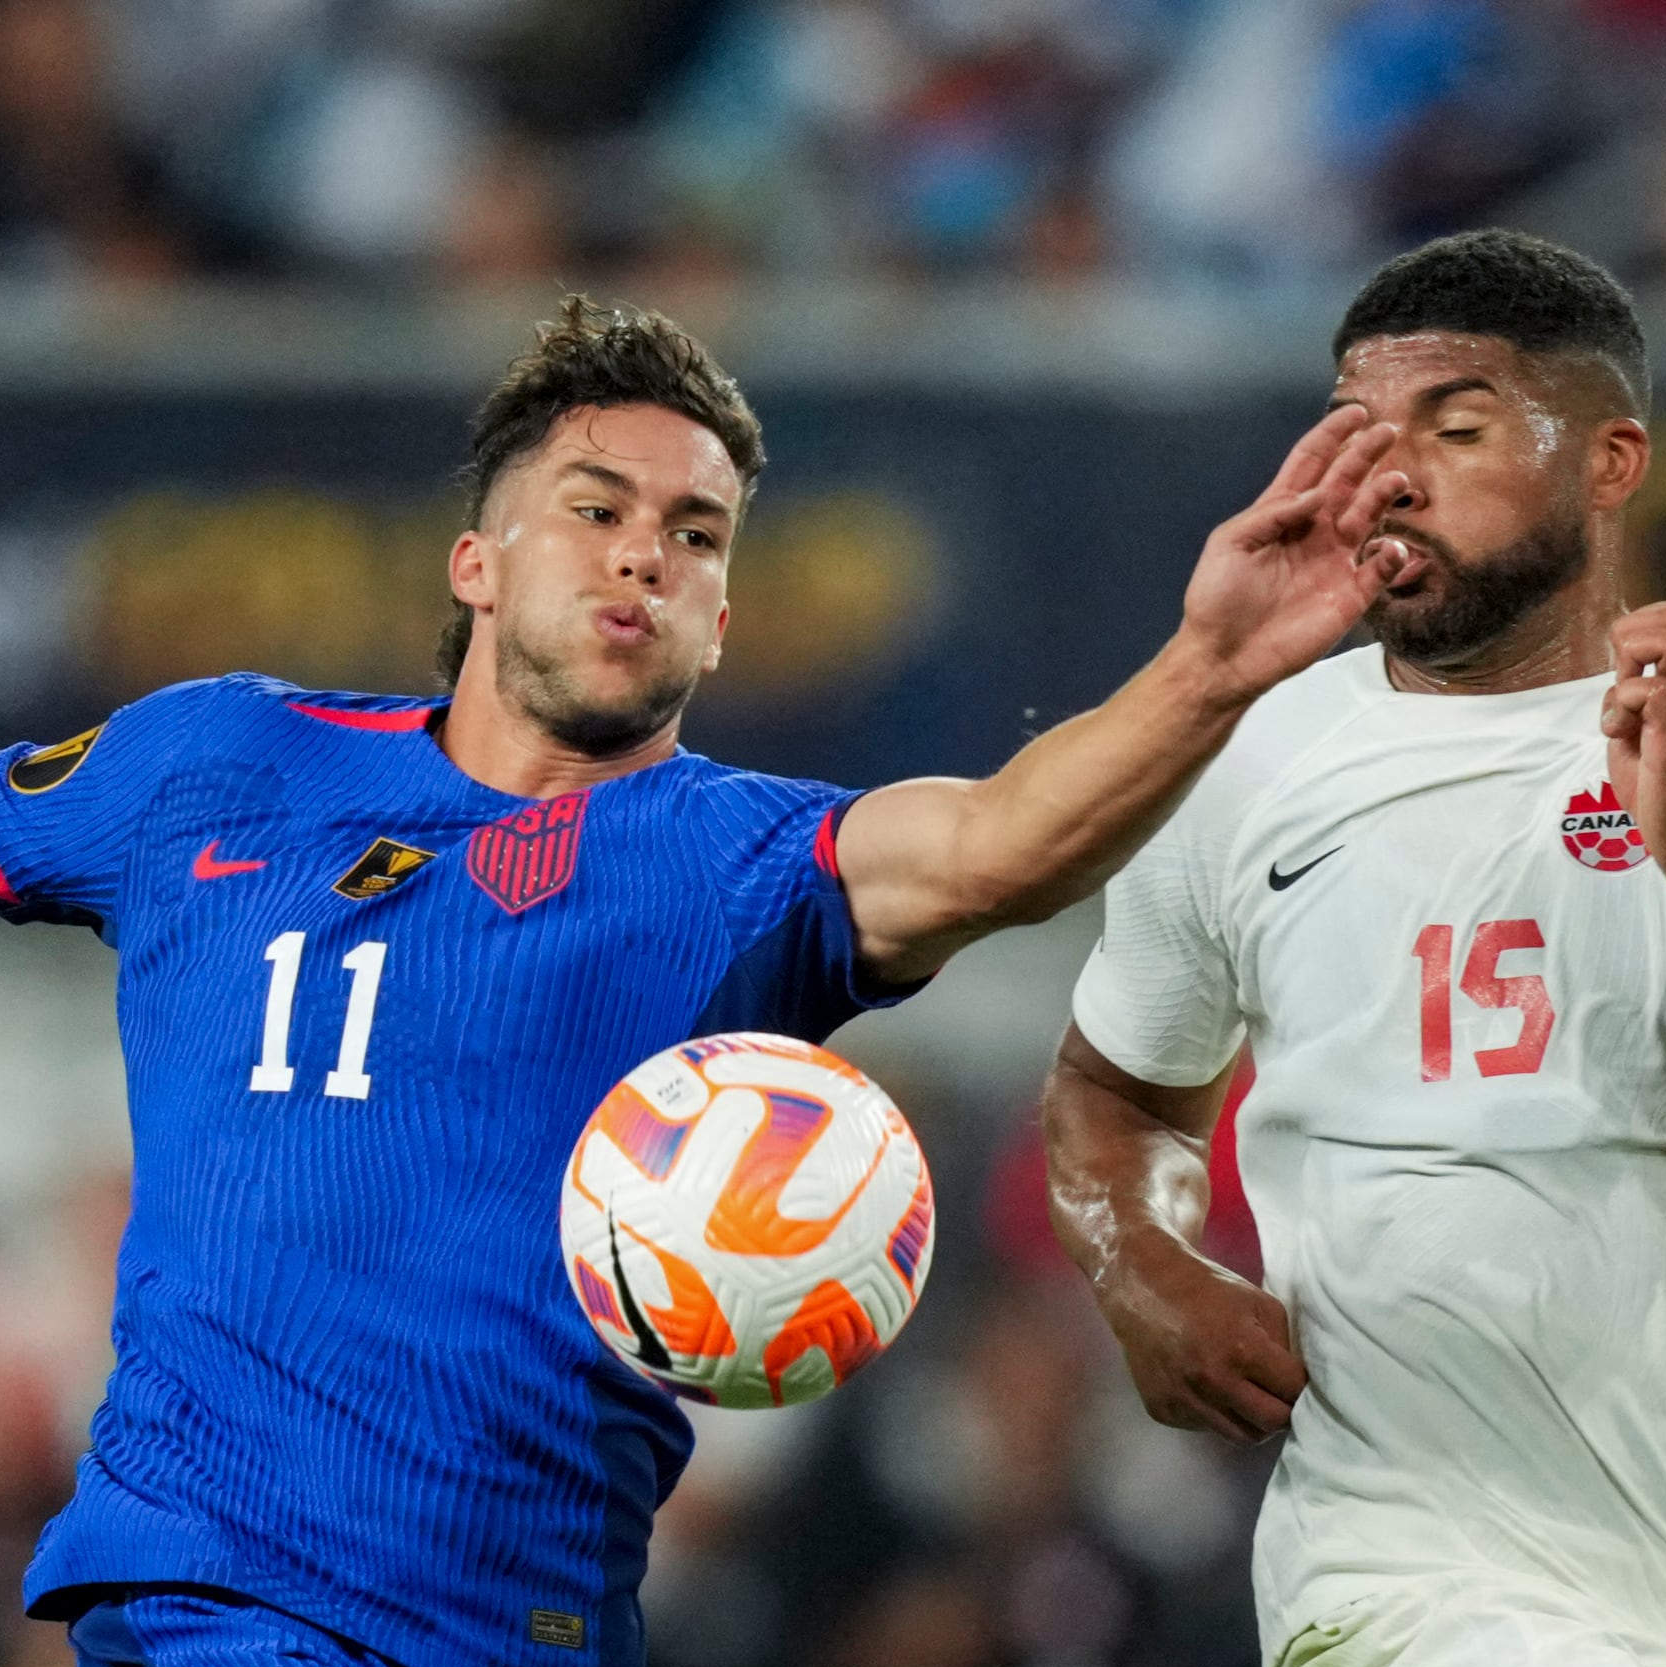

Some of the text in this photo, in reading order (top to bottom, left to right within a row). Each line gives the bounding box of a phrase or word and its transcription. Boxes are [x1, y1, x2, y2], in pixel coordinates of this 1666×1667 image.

[495, 797, 580, 835] SA
[1561, 813, 1638, 832] CANA
[249, 930, 388, 1101] 11
[1411, 918, 1556, 1083] 15
